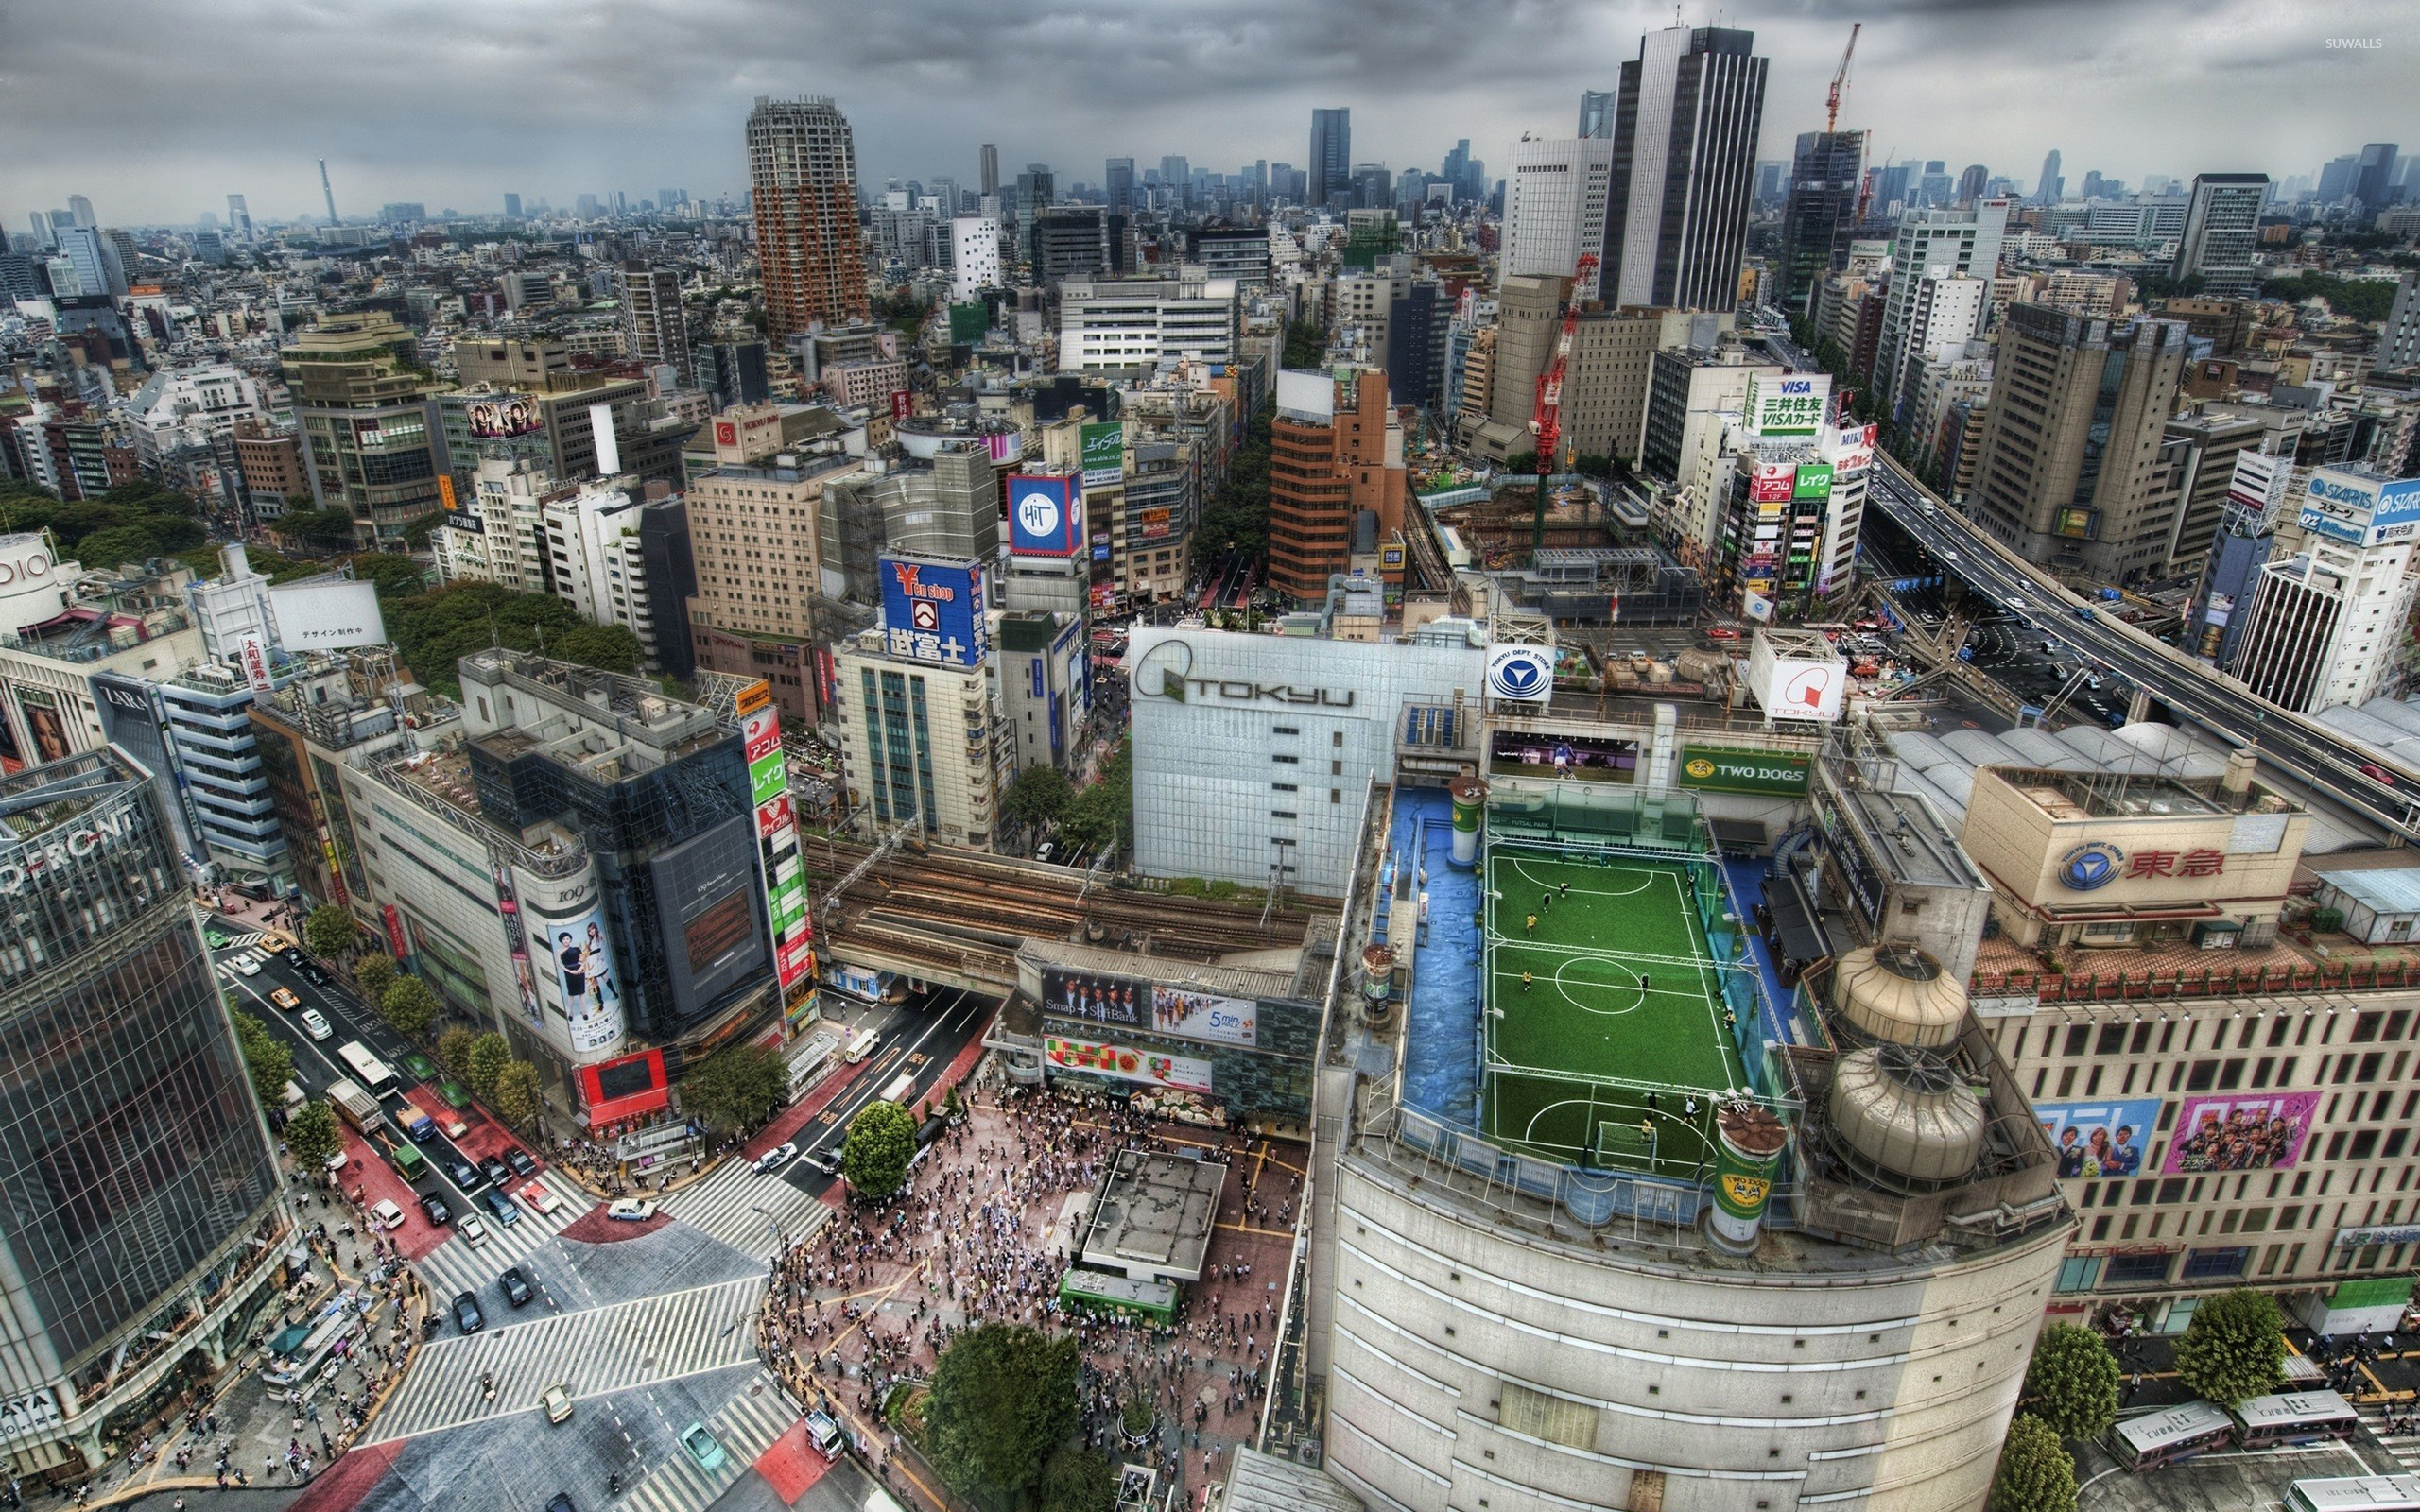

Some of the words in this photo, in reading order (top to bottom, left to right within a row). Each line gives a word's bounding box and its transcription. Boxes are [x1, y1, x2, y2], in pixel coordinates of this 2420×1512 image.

[1781, 381, 1811, 393] VISA
[1764, 397, 1823, 412] 三井住友
[744, 418, 766, 431] TOKYU
[1762, 413, 1821, 426] VISAカード
[1841, 431, 1863, 446] MIKI
[1762, 480, 1789, 490] アコム
[1799, 474, 1829, 487] レイク
[2325, 483, 2372, 508] STARTS
[2318, 502, 2354, 519] スターツ
[928, 584, 954, 602] shop
[302, 627, 363, 639] デザイン制作中
[890, 627, 966, 664] 武富士
[245, 639, 266, 680] 大和証券
[1492, 651, 1511, 667] TOKYU
[1533, 653, 1551, 670] STORE
[99, 686, 148, 711] ZARA
[1186, 678, 1354, 708] TOKYU
[1771, 707, 1836, 718] TOKYU
[750, 736, 782, 759] アコム
[752, 762, 784, 792] レイク
[1717, 765, 1755, 778] TWO
[1757, 768, 1805, 782] DOGS
[761, 812, 790, 837] アイフル
[2062, 843, 2085, 863] TOKYU
[2108, 844, 2125, 862] STORE
[2125, 848, 2225, 880] 東急
[1840, 850, 1859, 892] FUTSAL
[1858, 885, 1876, 922] PARK
[714, 951, 735, 967] Panasonic
[1046, 1000, 1076, 1015] Smap
[1209, 1011, 1221, 1027] 5
[1748, 1178, 1768, 1189] DOGS
